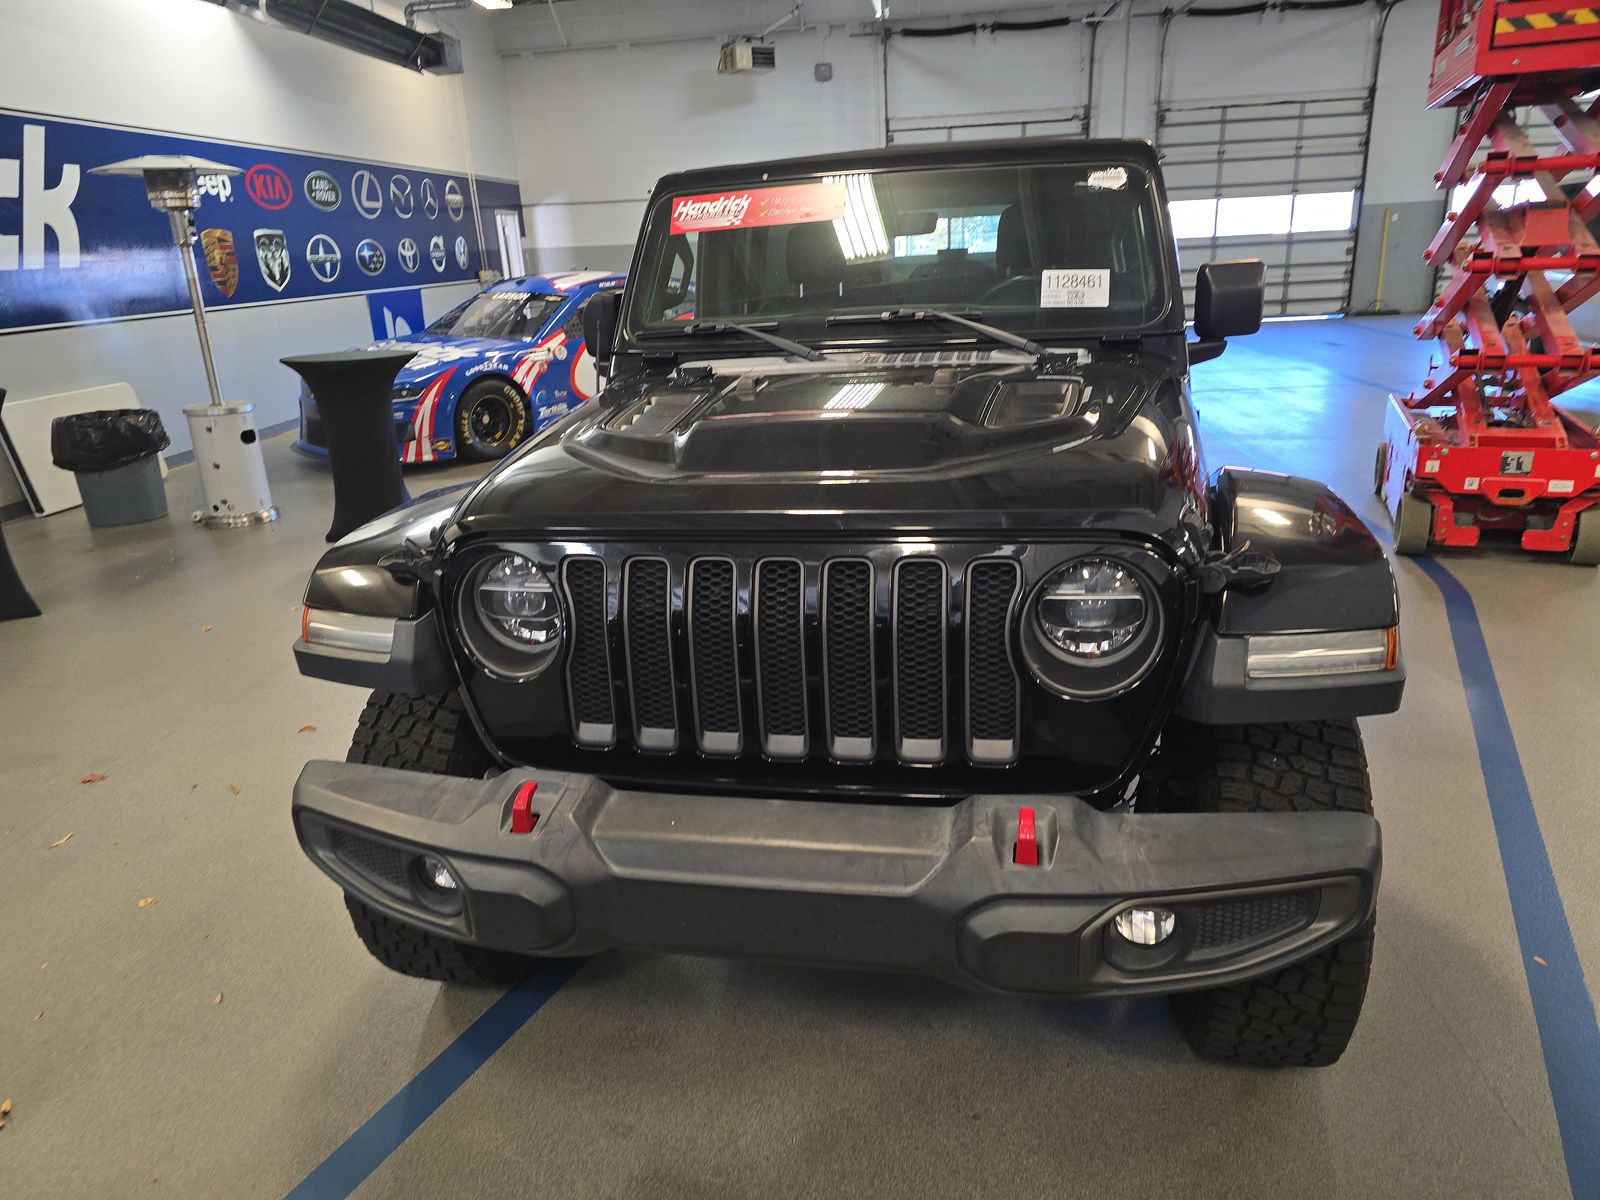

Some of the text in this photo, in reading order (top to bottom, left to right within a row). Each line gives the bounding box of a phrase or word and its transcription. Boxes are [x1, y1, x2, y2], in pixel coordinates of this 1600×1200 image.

[197, 174, 232, 203] eep
[252, 174, 288, 201] KIA
[312, 178, 330, 191] LAND
[673, 193, 753, 222] Hendrick
[1046, 274, 1104, 289] 1128461
[491, 291, 532, 301] LARSON
